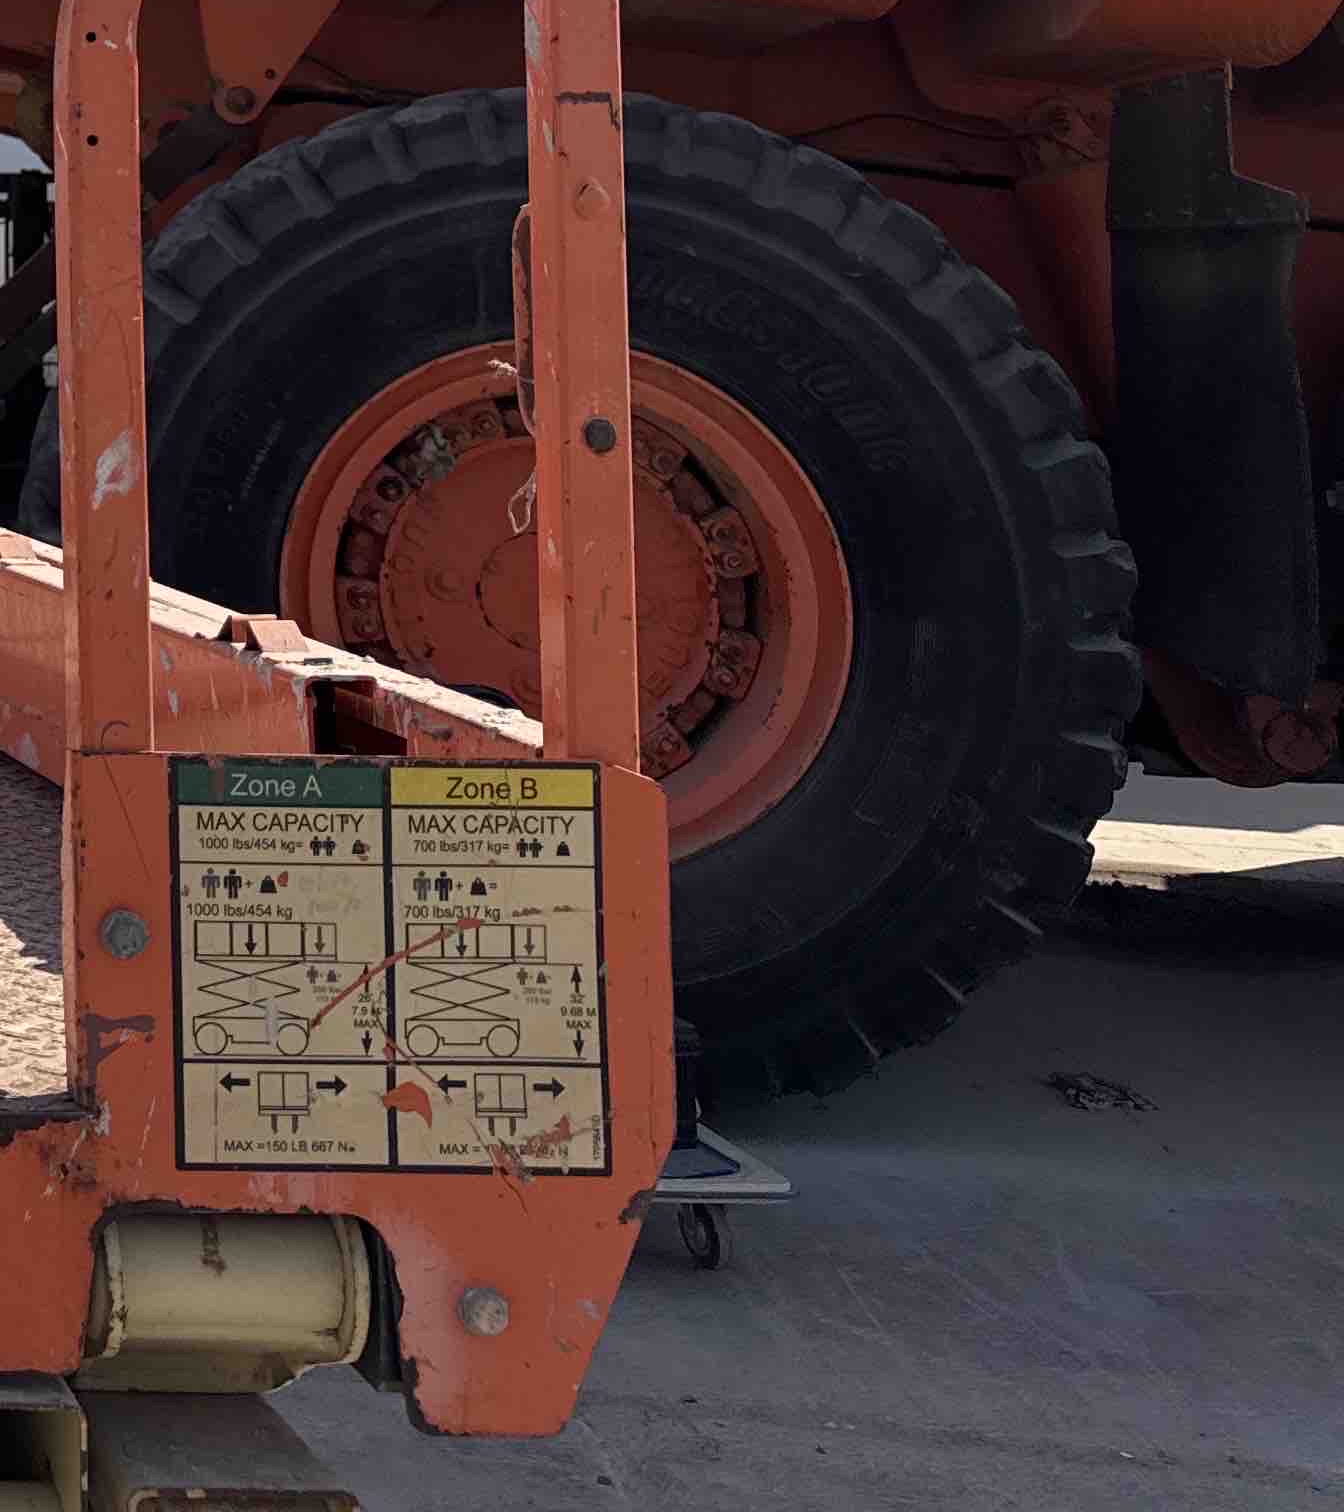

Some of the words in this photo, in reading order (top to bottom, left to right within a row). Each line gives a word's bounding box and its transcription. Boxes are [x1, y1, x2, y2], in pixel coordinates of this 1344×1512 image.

[229, 772, 297, 798] Zone
[301, 774, 323, 798] A
[445, 776, 512, 800] Zone
[520, 777, 539, 800] B
[195, 810, 247, 832] MAX
[251, 812, 365, 833] CAPACITY
[408, 814, 457, 834] MAX
[462, 815, 575, 835] CAPACITY
[198, 837, 230, 850] 1000
[232, 838, 277, 851] lbs/454
[413, 839, 437, 853] 700
[439, 840, 484, 853] lbs/317
[186, 903, 220, 917] 1000
[223, 903, 273, 918] lbs/454
[276, 905, 293, 920] kg
[404, 905, 429, 919] 700
[432, 905, 481, 919] lbs/317
[484, 906, 501, 921] kg
[565, 1019, 592, 1030] MAX
[223, 1140, 254, 1153] MAX
[291, 1141, 309, 1153] LB
[439, 1143, 469, 1155] MAX
